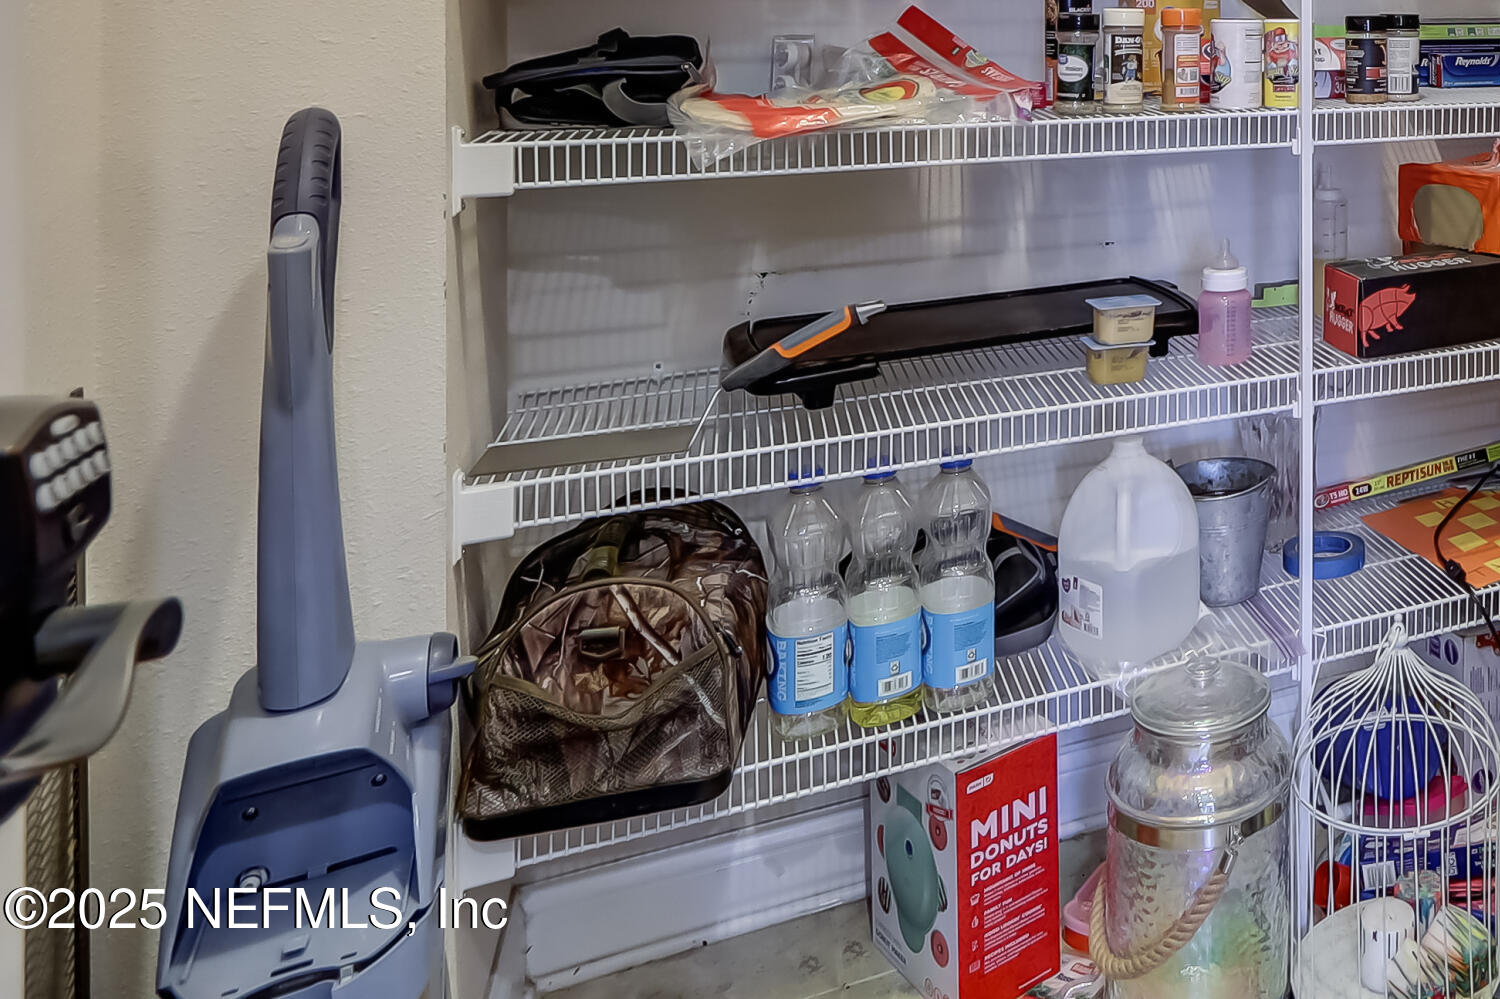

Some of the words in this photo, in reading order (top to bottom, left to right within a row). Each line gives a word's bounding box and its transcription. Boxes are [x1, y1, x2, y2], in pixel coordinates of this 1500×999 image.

[1455, 56, 1491, 67] Reynolds
[1388, 255, 1474, 272] HUGGER
[1386, 463, 1442, 489] REPTISUN
[970, 785, 1047, 850] MINI
[970, 817, 1048, 870] DONUTS
[970, 862, 1001, 887] FOR
[1006, 836, 1049, 869] DAYS!
